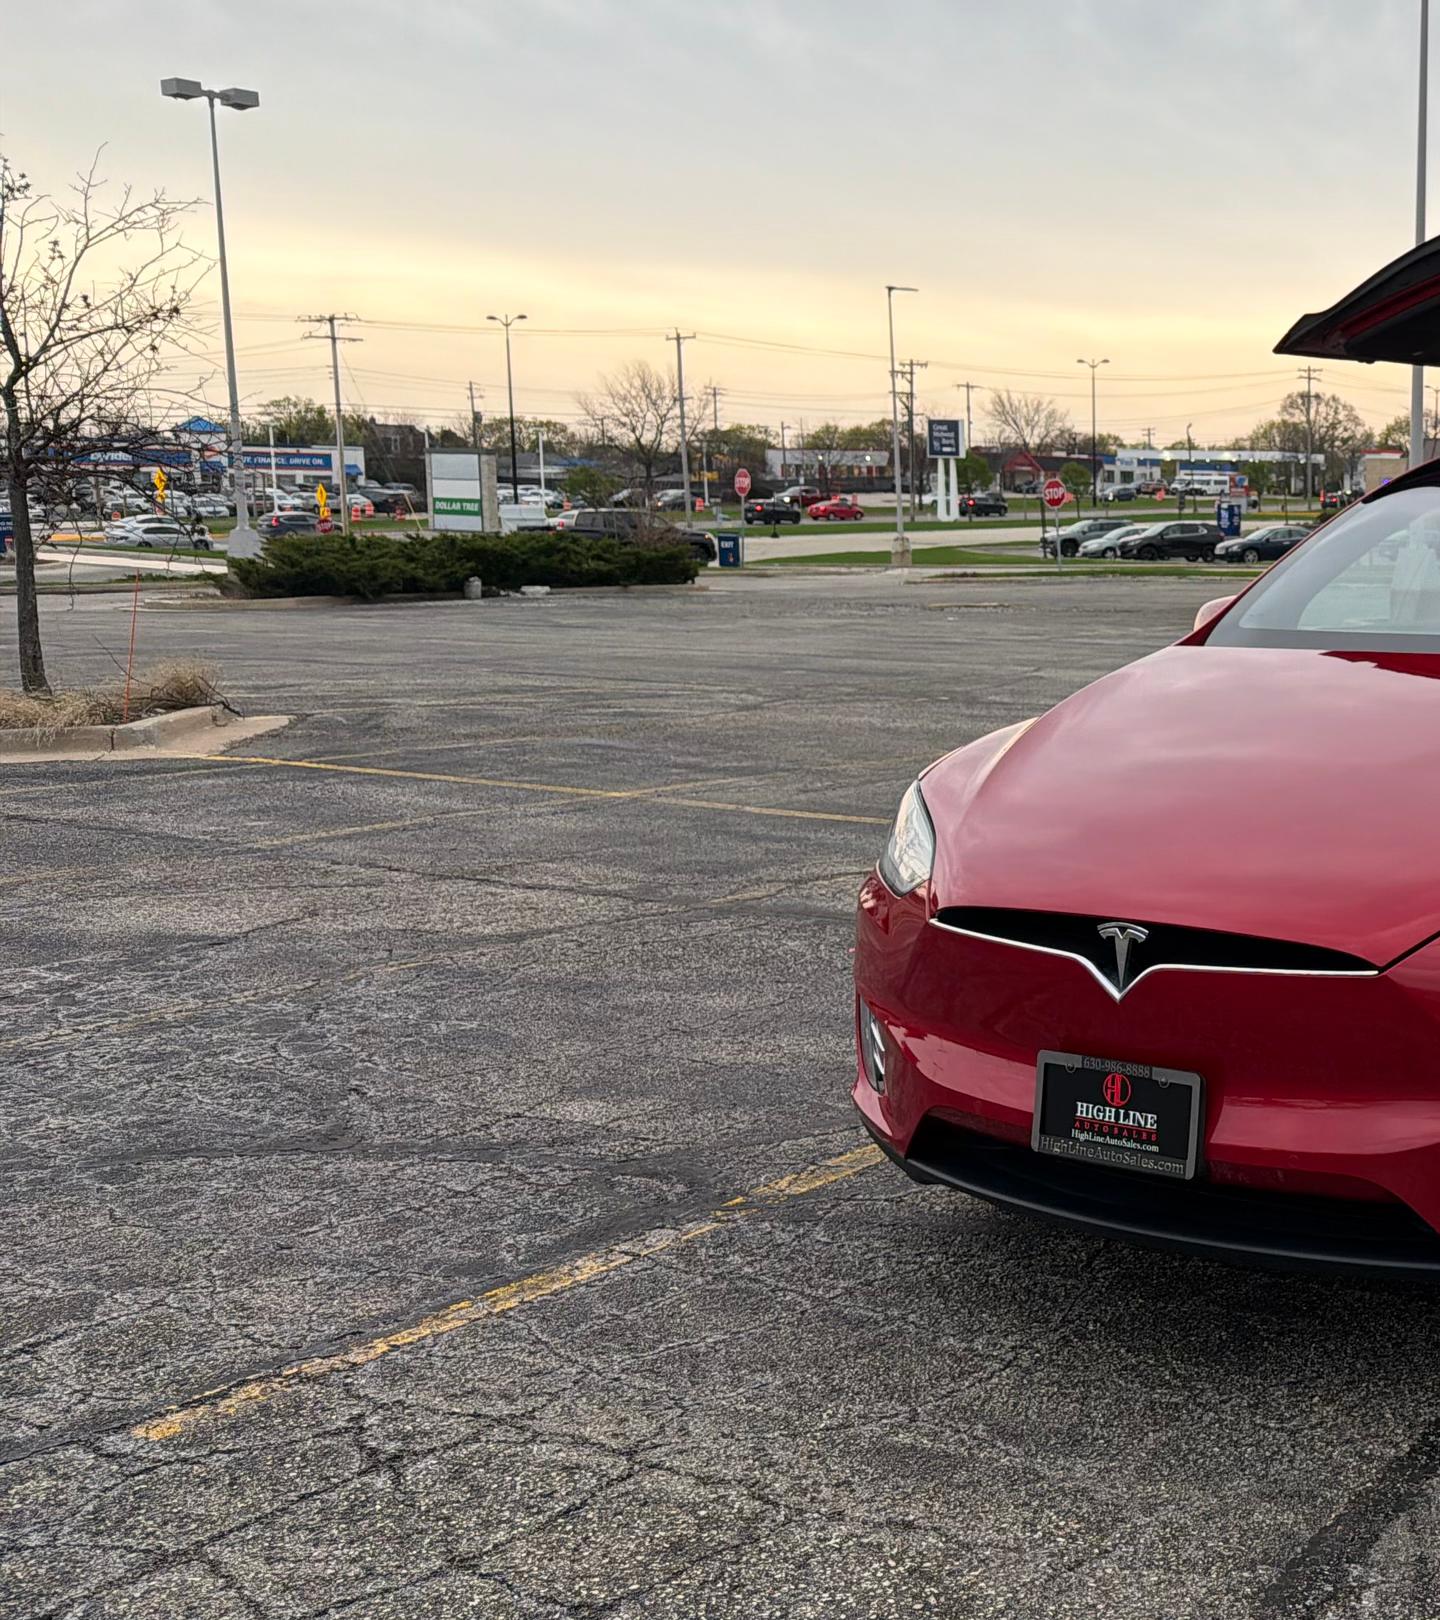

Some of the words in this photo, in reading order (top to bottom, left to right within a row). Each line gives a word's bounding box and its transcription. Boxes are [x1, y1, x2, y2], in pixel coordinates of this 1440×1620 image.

[1045, 487, 1065, 500] STOP
[435, 501, 461, 511] DOLLAR
[462, 502, 480, 512] TREE
[1082, 1056, 1151, 1079] 630-986-8888
[1075, 1101, 1116, 1123] HIGH
[1118, 1109, 1158, 1130] LINE
[1071, 1128, 1160, 1153] HighLineAutoSales.com
[1040, 1136, 1185, 1175] HighLineAutoSales.com
